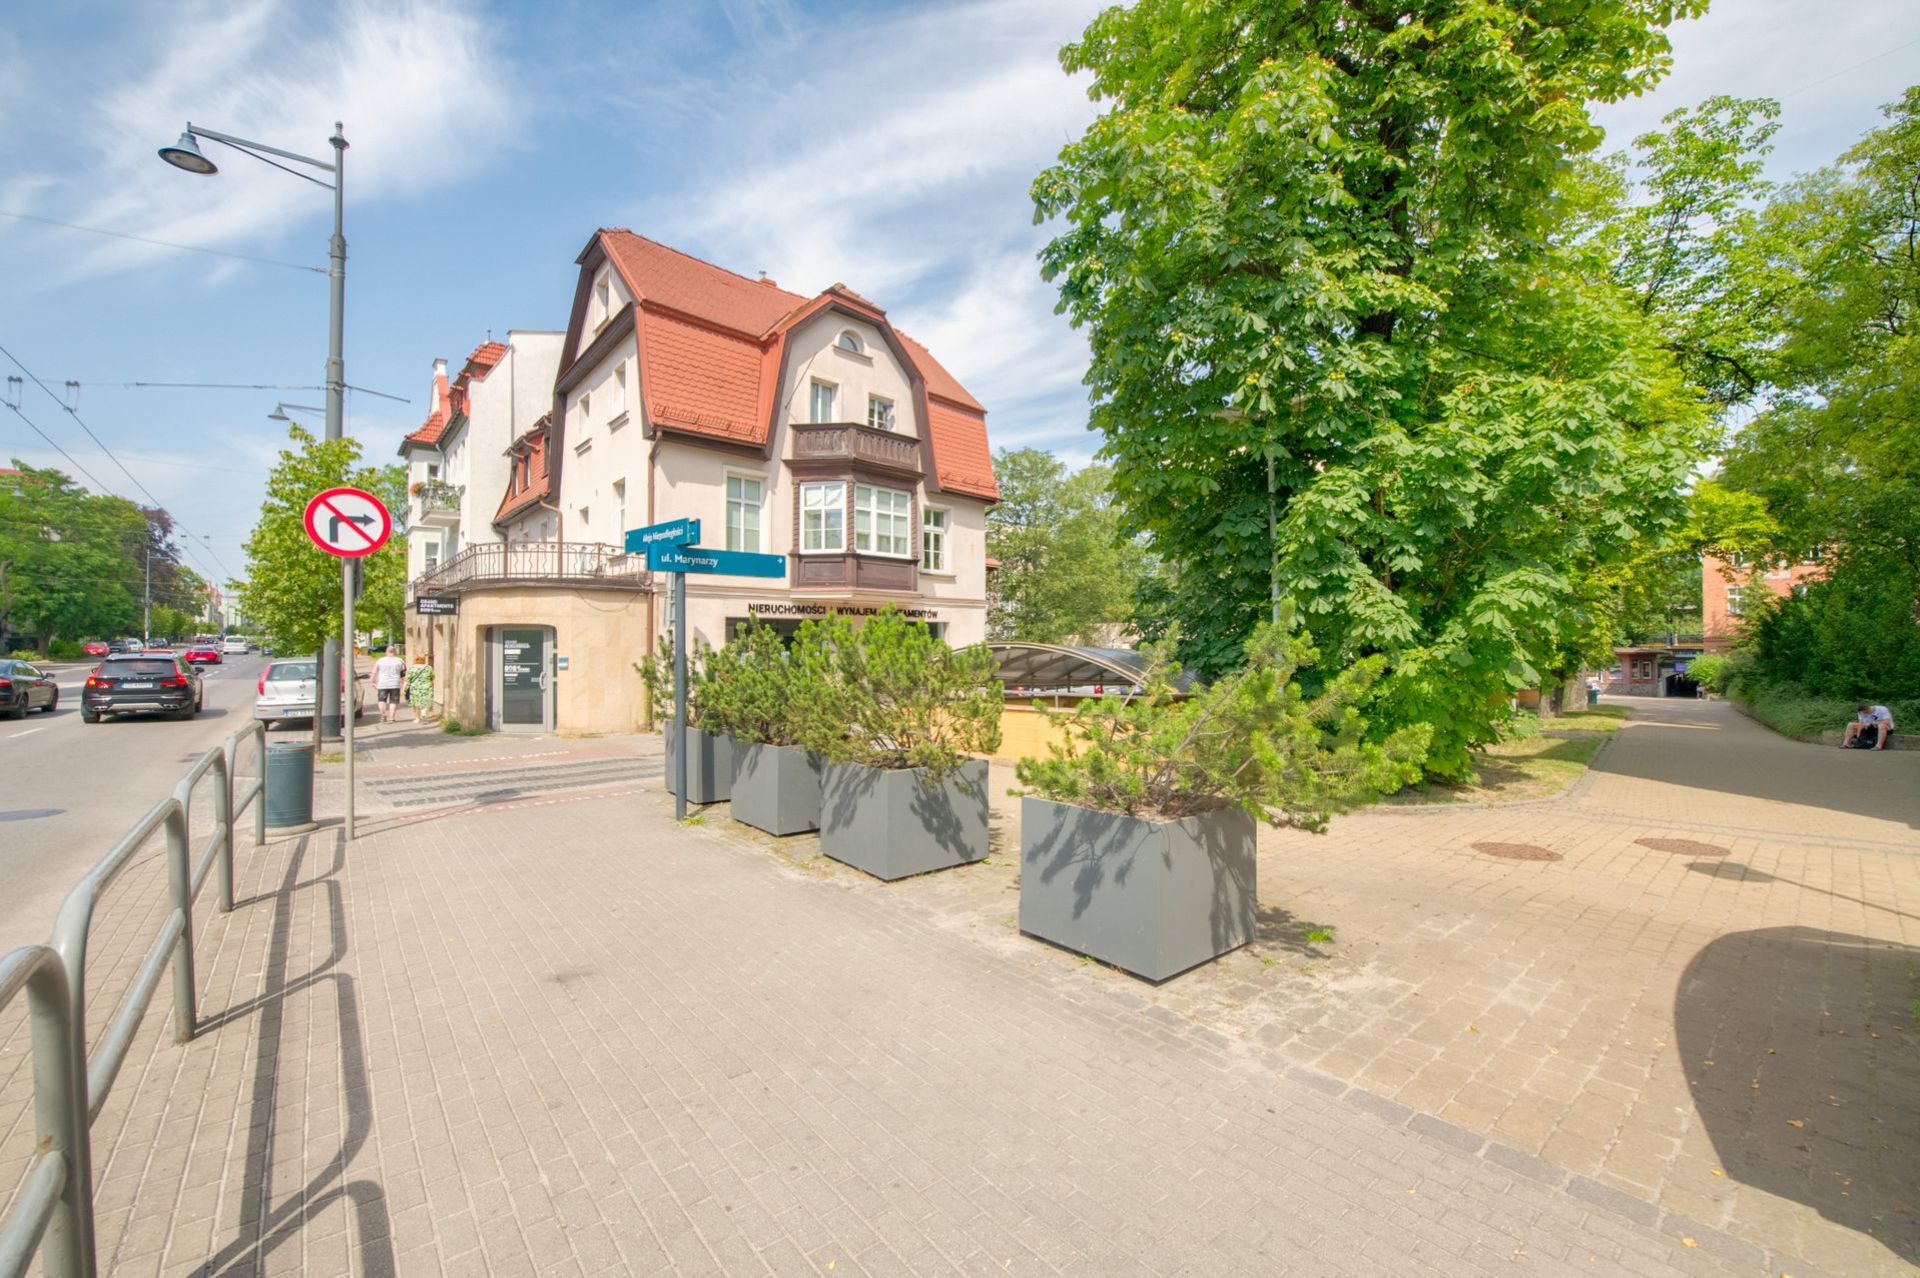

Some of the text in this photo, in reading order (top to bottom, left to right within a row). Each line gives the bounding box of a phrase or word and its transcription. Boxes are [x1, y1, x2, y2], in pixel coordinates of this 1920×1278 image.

[661, 553, 719, 568] ul. Marynarzy
[748, 603, 826, 615] NIERUCHOMOŚCI
[837, 606, 877, 616] WYNAJEM
